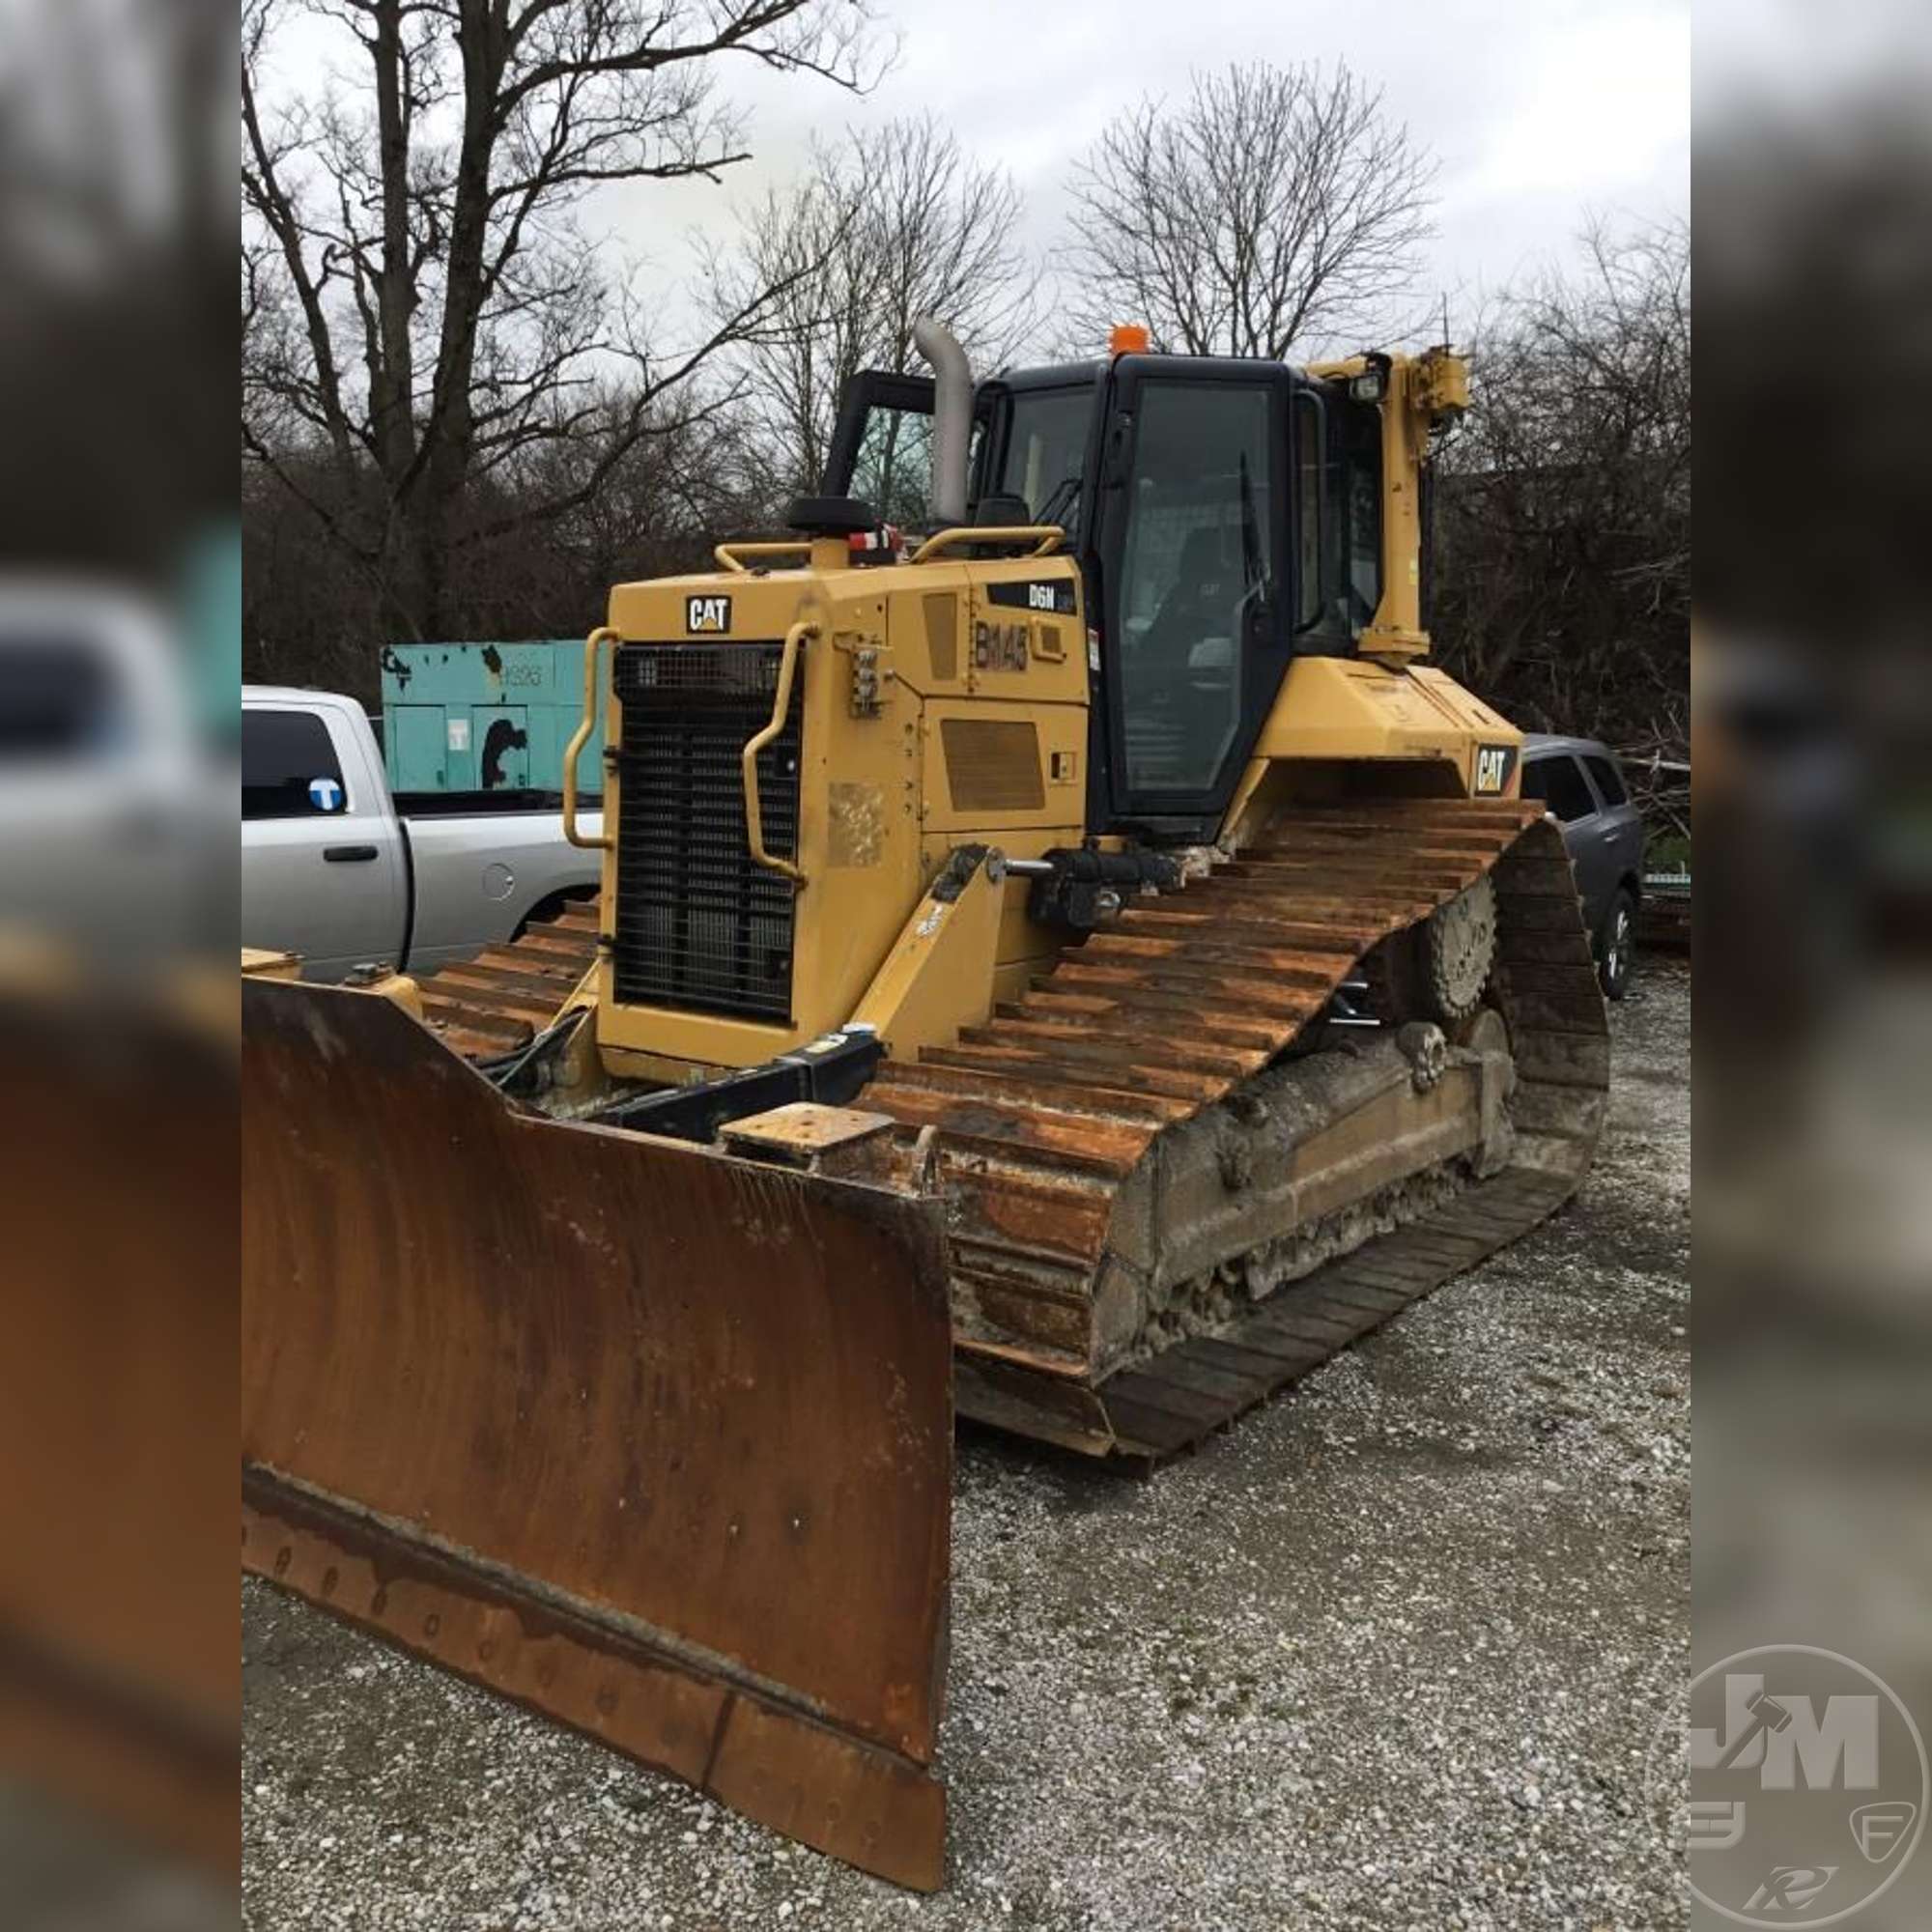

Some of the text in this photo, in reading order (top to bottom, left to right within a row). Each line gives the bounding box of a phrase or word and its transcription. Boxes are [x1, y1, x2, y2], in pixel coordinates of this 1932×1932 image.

[1029, 583, 1055, 611] D6N
[690, 599, 728, 631] CAT
[1478, 750, 1506, 791] CAT
